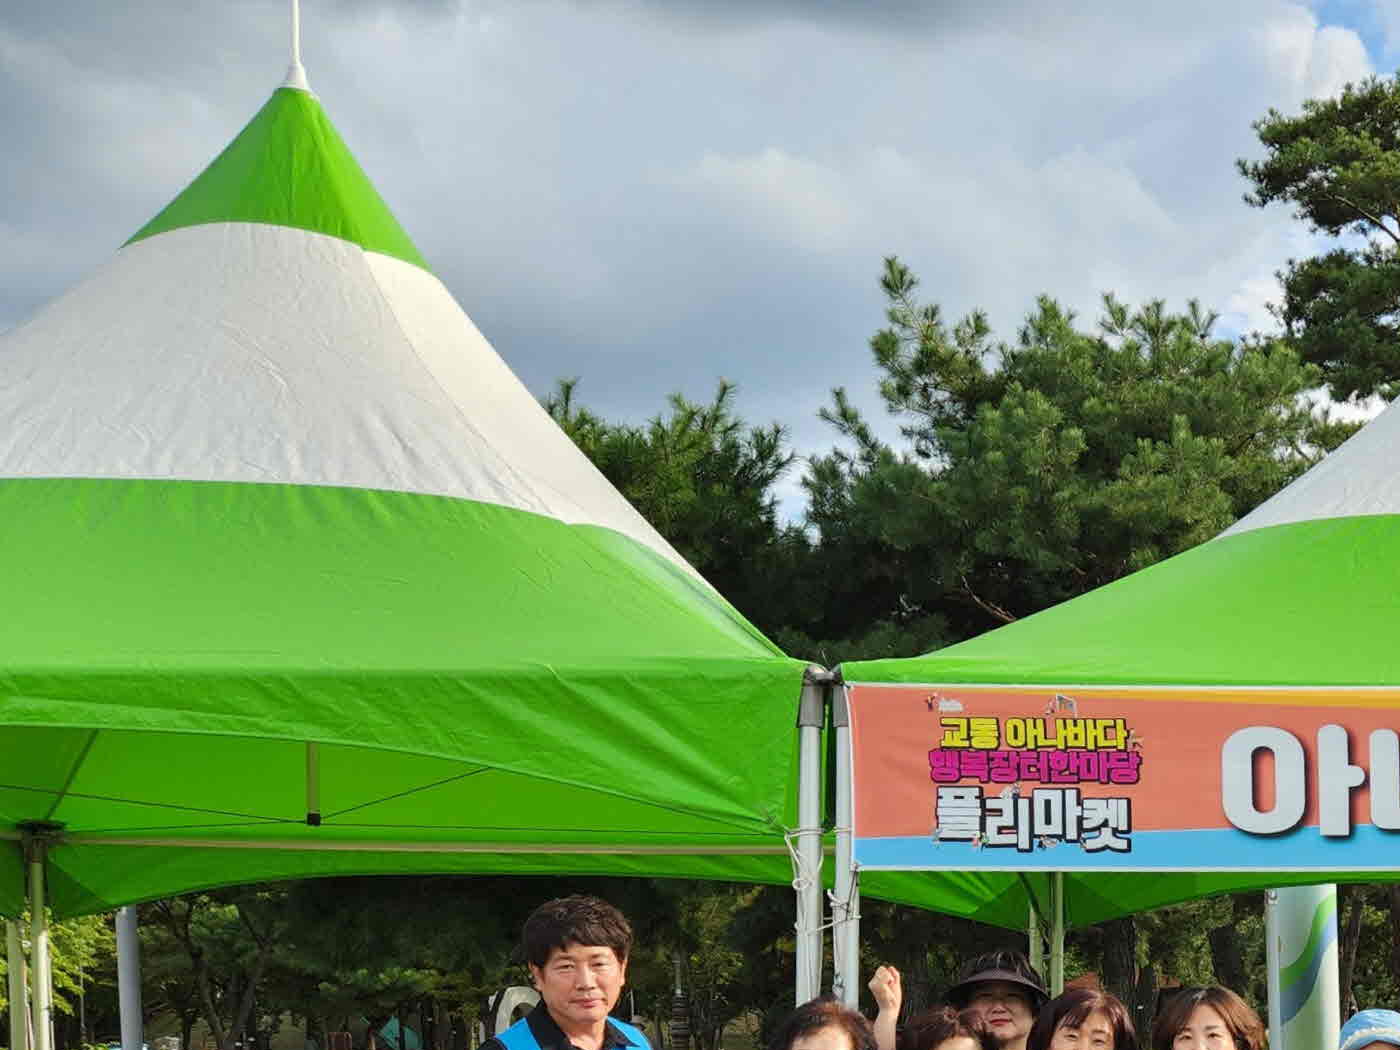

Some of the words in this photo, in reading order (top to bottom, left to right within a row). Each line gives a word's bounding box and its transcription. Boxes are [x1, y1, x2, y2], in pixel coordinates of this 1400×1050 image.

[940, 717, 1000, 749] 교동
[1005, 717, 1129, 749] 아나바다
[929, 749, 1141, 784] 행복장터한마당
[936, 786, 1131, 852] 플리마켓
